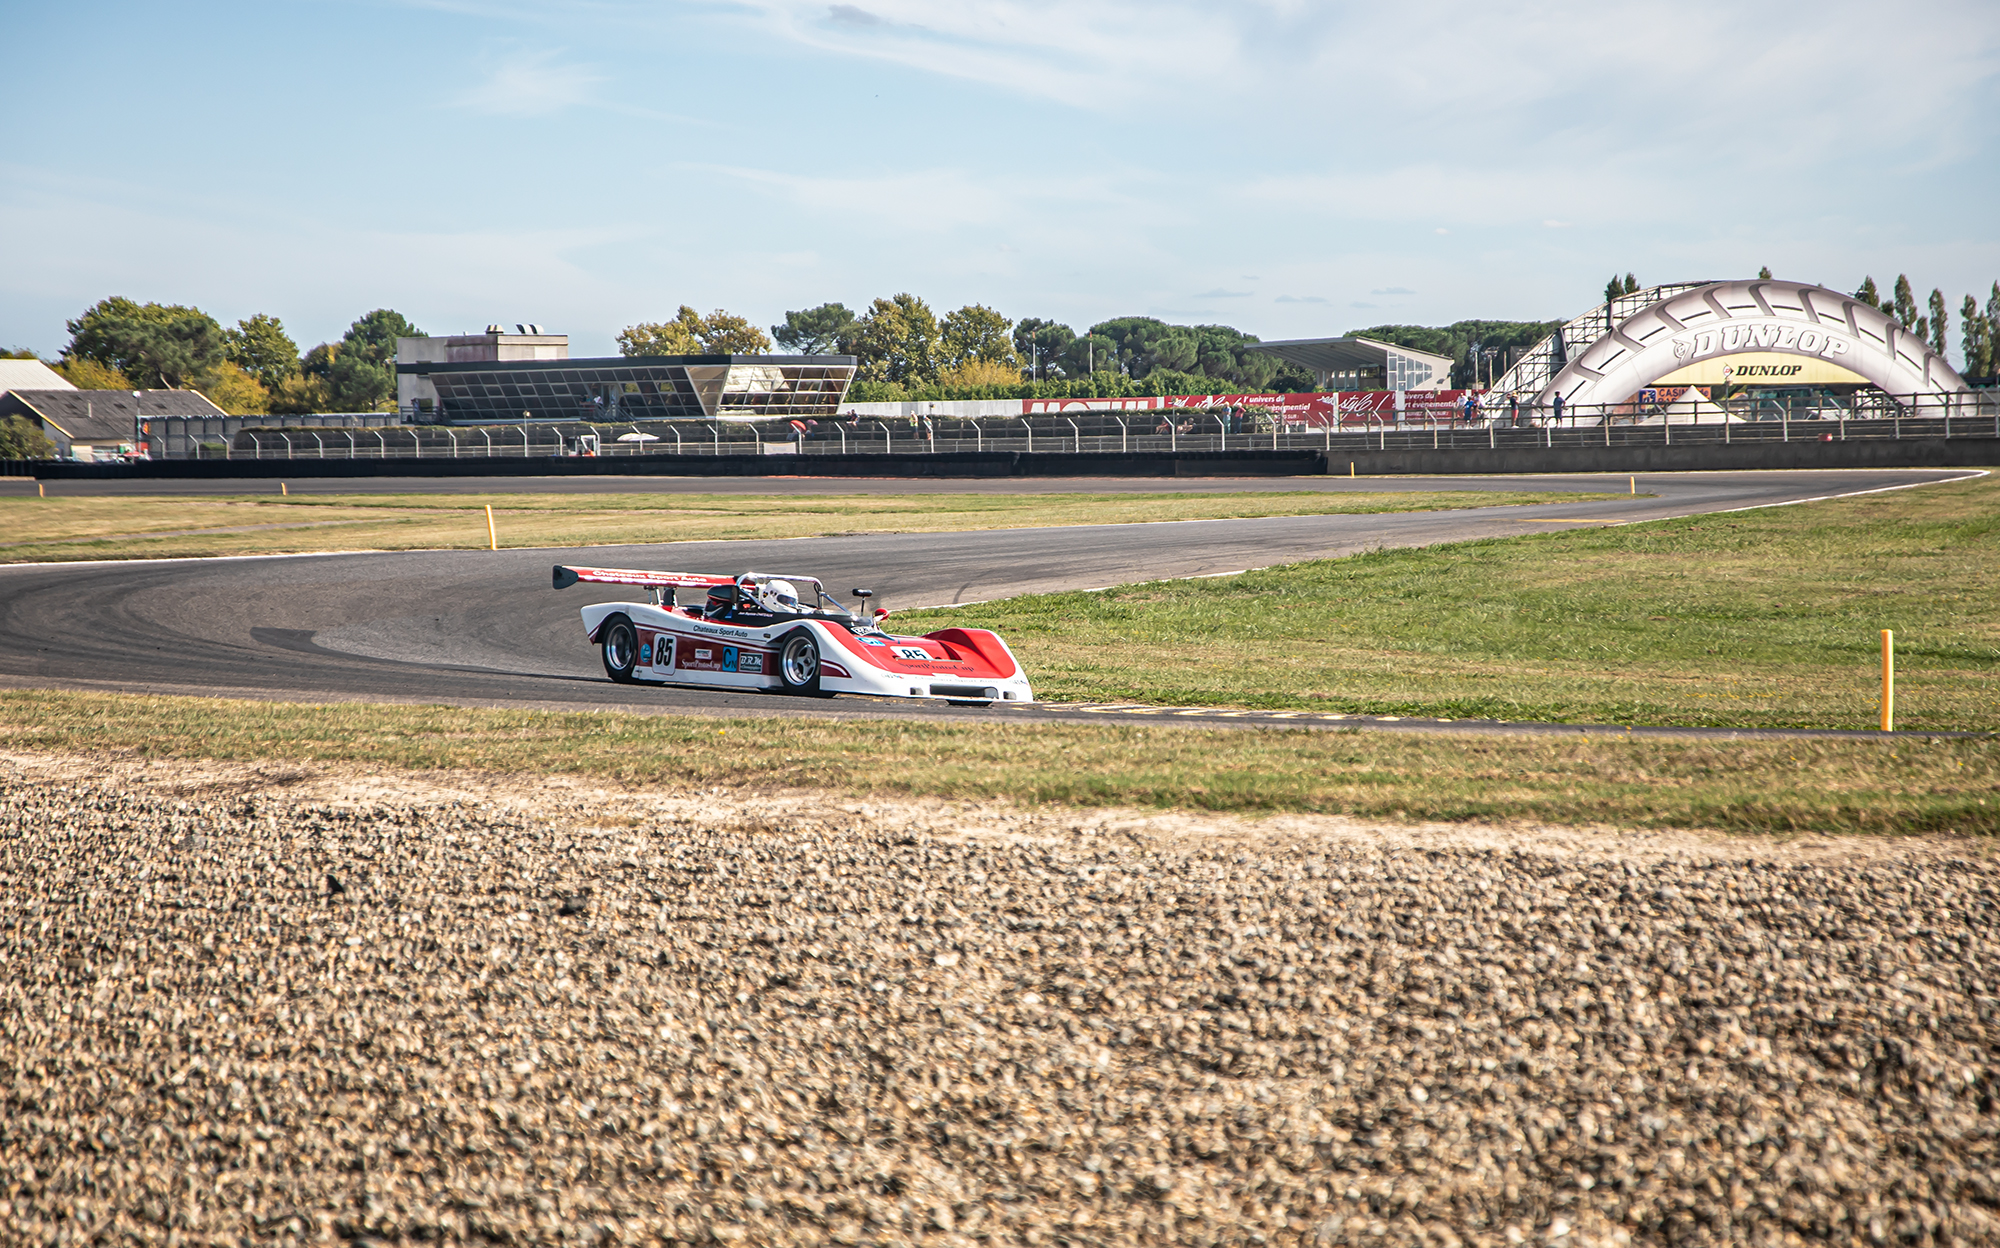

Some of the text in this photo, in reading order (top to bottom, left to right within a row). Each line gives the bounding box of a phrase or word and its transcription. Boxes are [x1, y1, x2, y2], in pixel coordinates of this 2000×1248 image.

[1691, 324, 1850, 359] DUNLOP
[1735, 365, 1802, 376] DUNLOP
[693, 625, 748, 638] Chateaux Sport Auto
[655, 636, 674, 667] 85
[901, 649, 927, 659] 85
